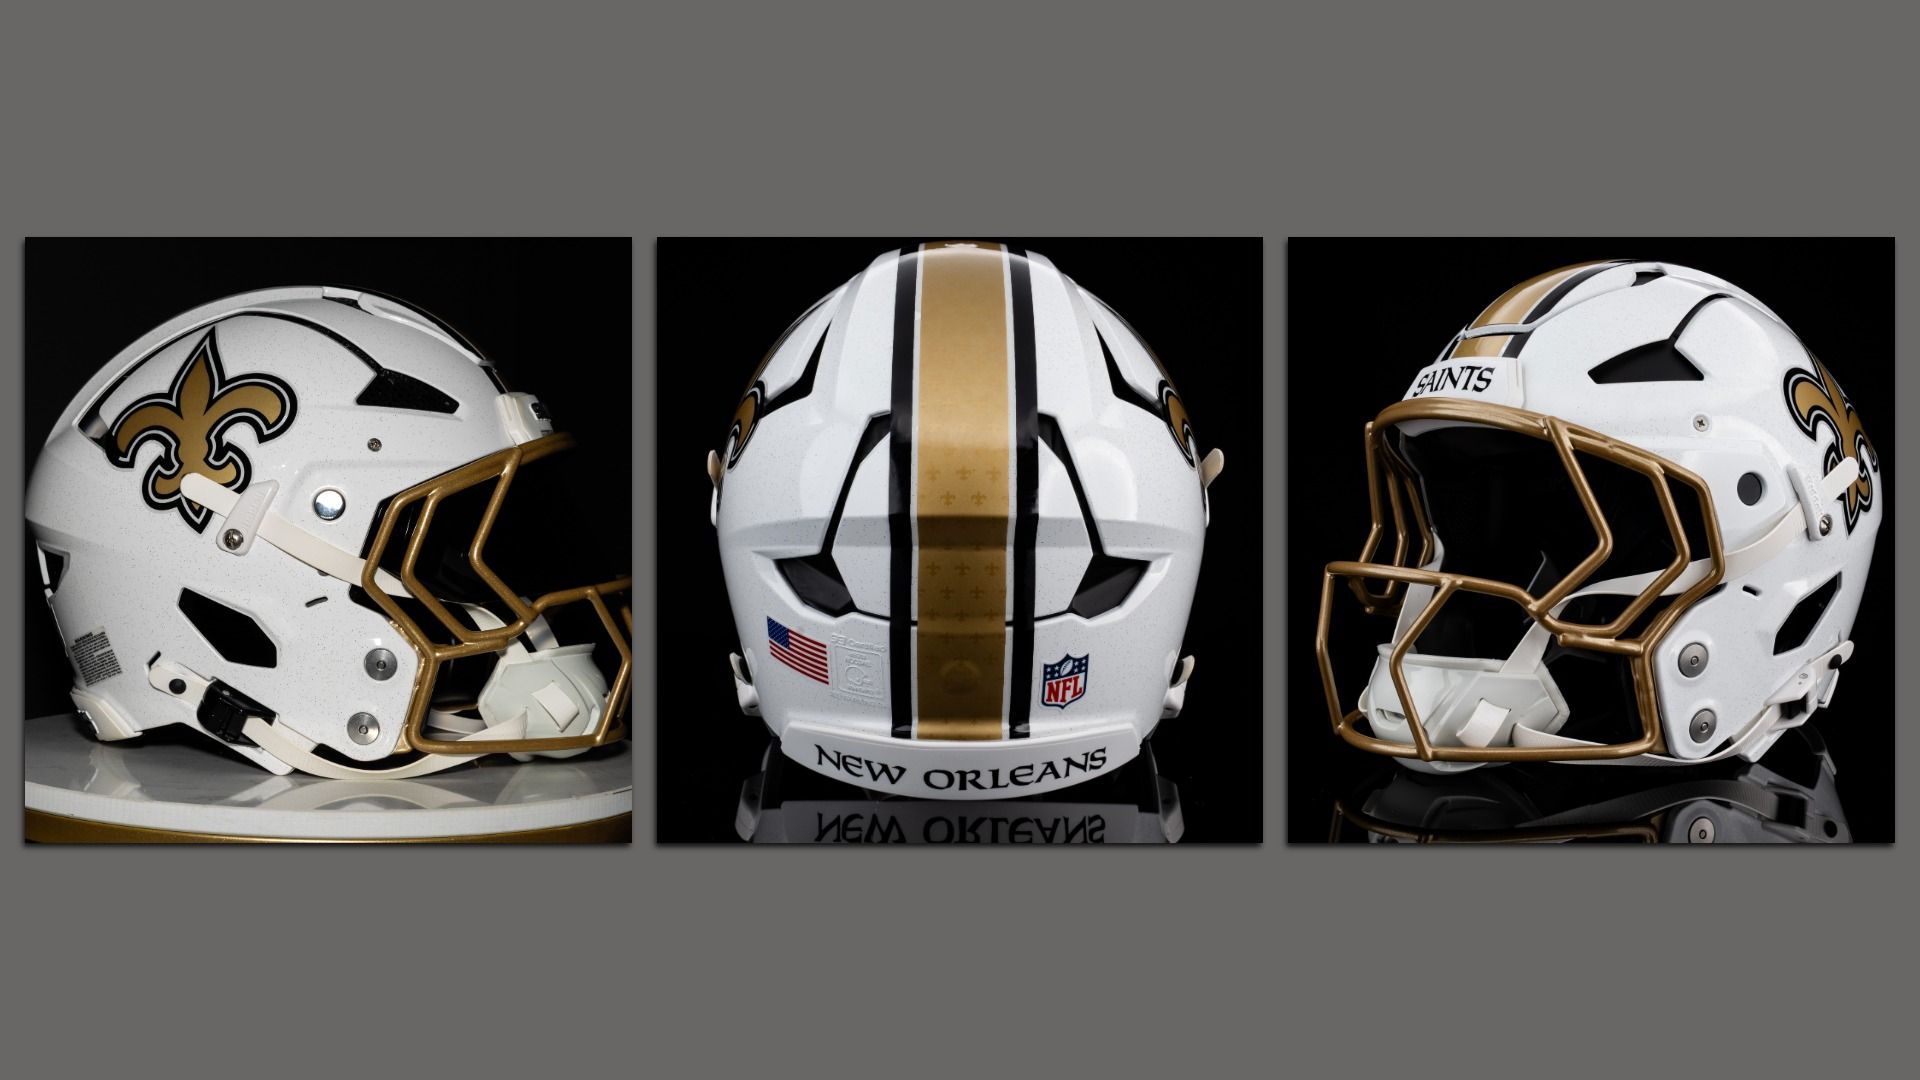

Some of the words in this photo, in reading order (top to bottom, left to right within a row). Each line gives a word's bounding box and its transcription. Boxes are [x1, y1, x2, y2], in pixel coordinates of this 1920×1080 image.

[1412, 365, 1496, 398] SAINTS
[1046, 675, 1083, 703] NFL
[814, 744, 907, 785] NEW
[923, 747, 1107, 791] ORLEANS
